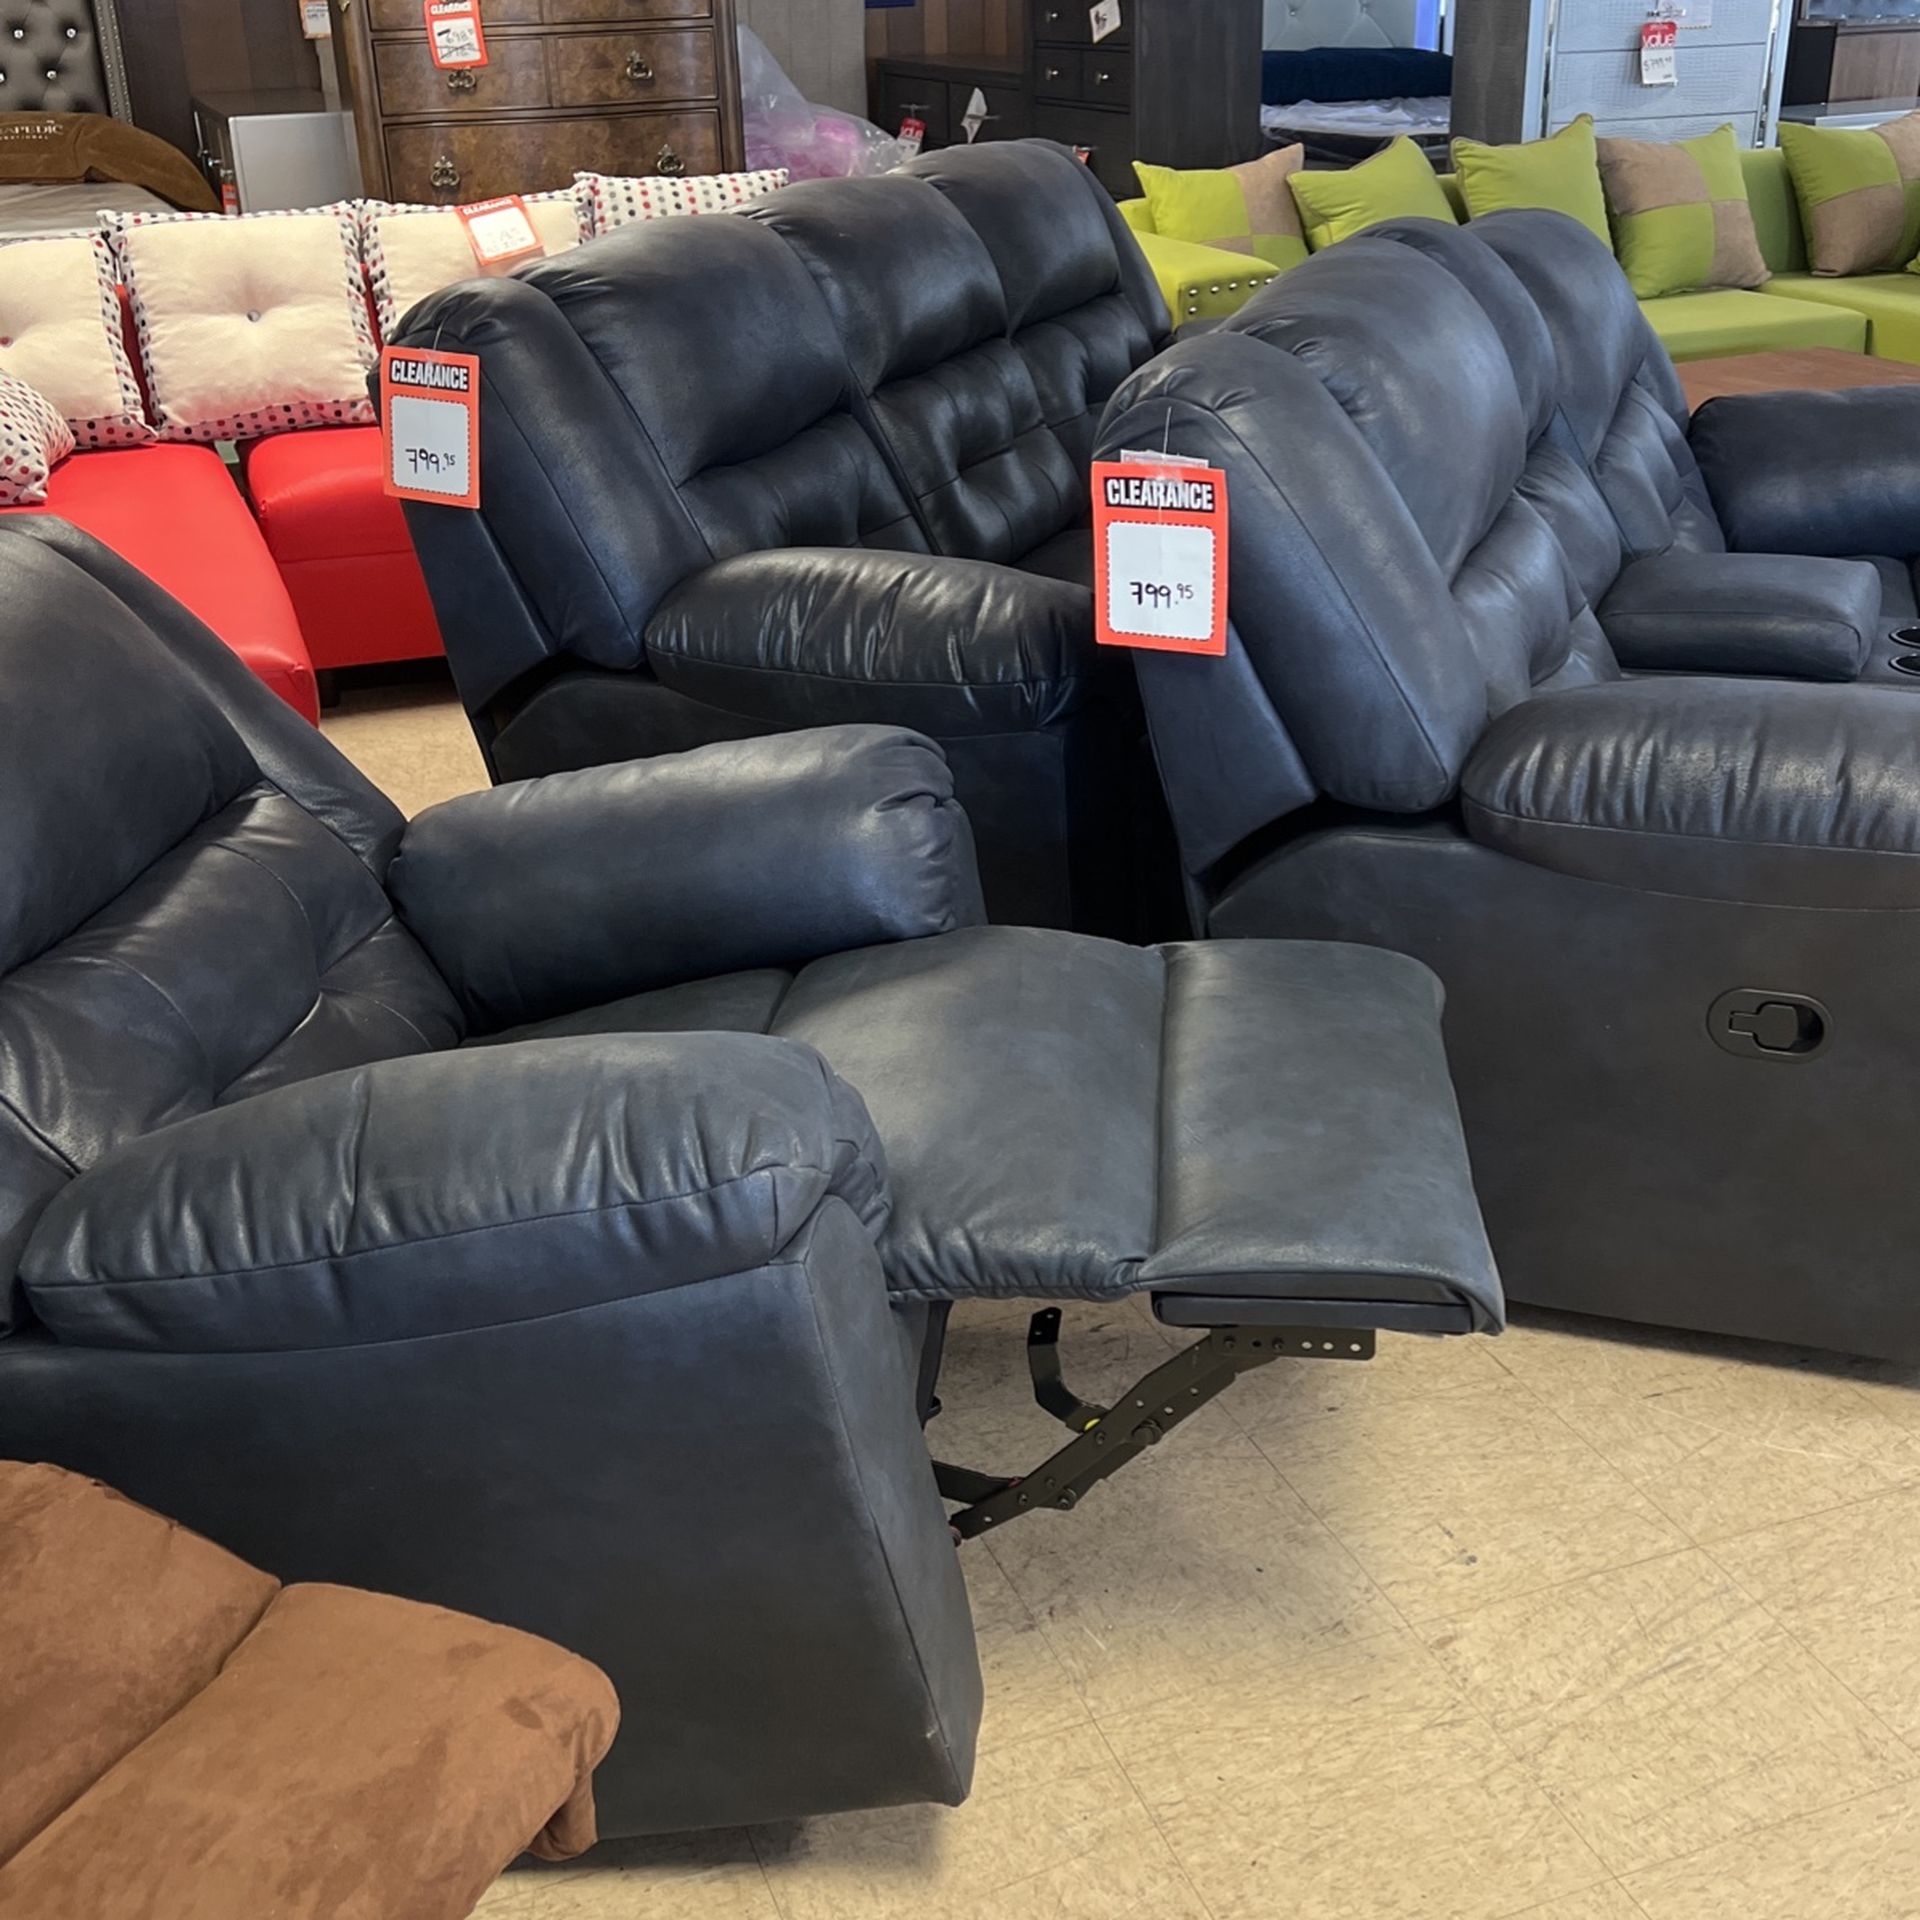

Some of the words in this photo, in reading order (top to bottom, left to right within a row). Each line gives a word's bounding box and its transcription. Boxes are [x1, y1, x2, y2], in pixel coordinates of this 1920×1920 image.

[462, 198, 513, 216] CLEARANCE
[391, 359, 468, 390] CLEARANCE
[405, 448, 456, 474] 799.95
[1106, 478, 1214, 511] CLEARANCE
[1130, 581, 1194, 609] 799.95
